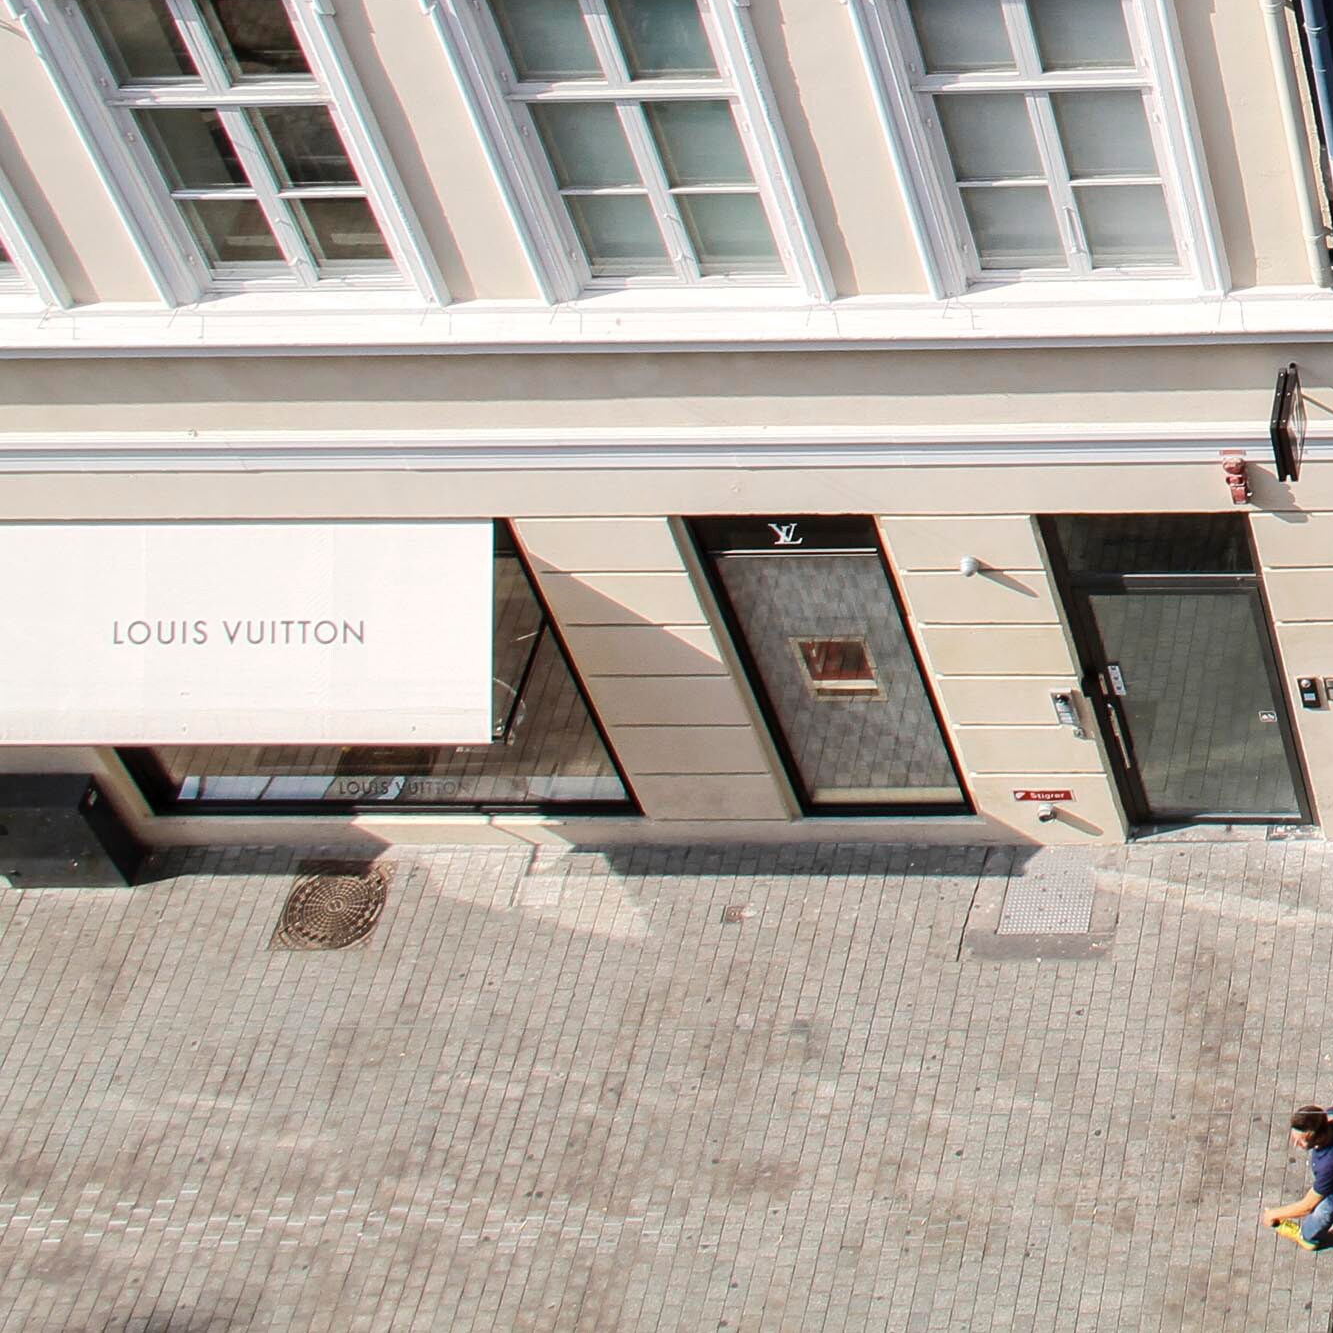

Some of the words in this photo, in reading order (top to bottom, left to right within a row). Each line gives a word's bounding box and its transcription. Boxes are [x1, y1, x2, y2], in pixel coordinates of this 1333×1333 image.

[113, 620, 208, 645] LOUIS
[222, 620, 365, 645] VUITTON
[338, 780, 390, 795] LOUIS
[396, 779, 471, 795] VUITTON
